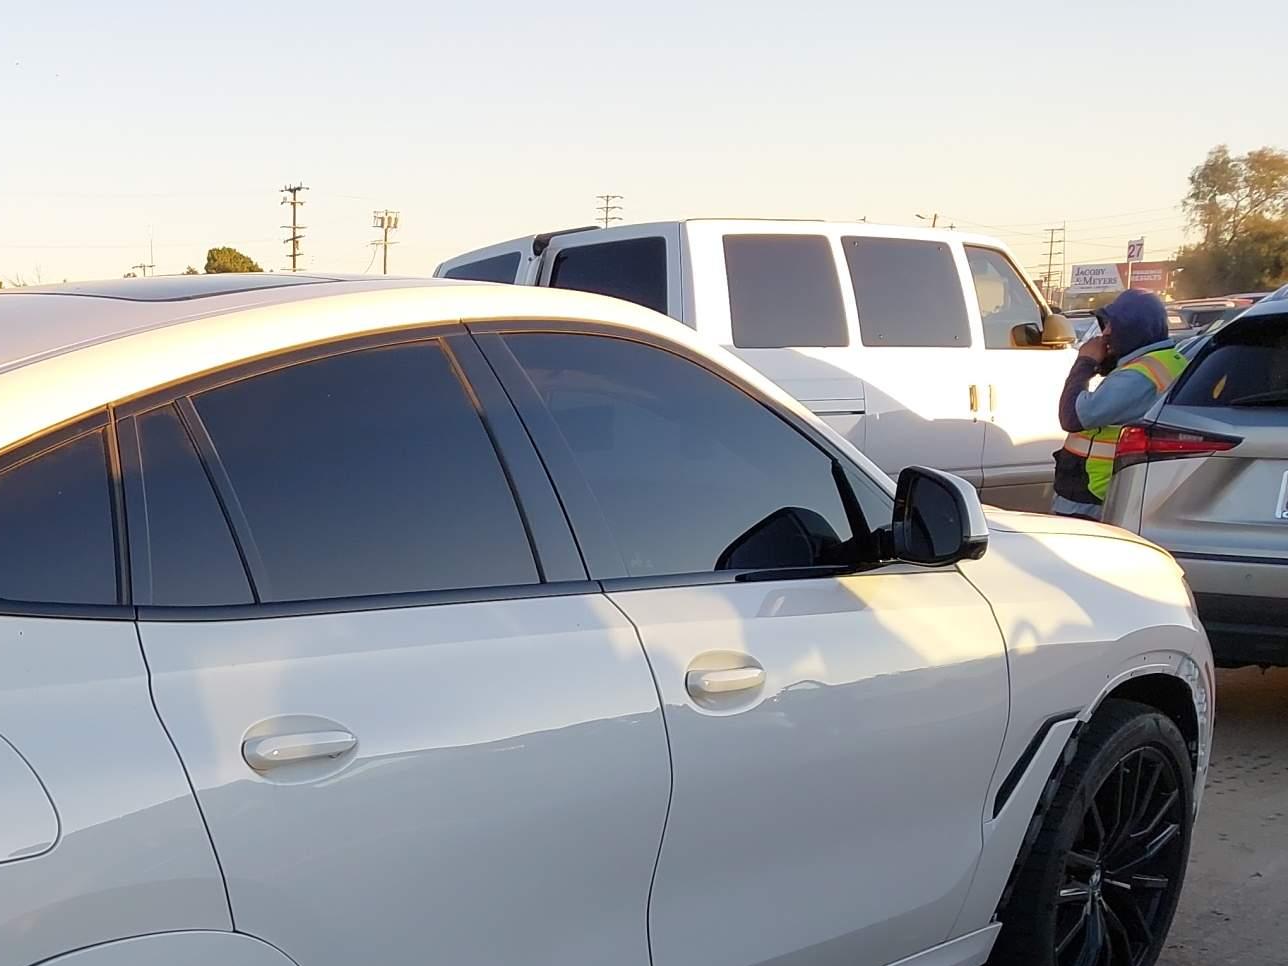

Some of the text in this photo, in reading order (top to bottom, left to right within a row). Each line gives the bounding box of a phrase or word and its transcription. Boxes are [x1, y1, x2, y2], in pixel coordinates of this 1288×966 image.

[1127, 243, 1144, 259] 27
[1075, 267, 1106, 276] JACOBY
[1083, 276, 1117, 285] MEYERS
